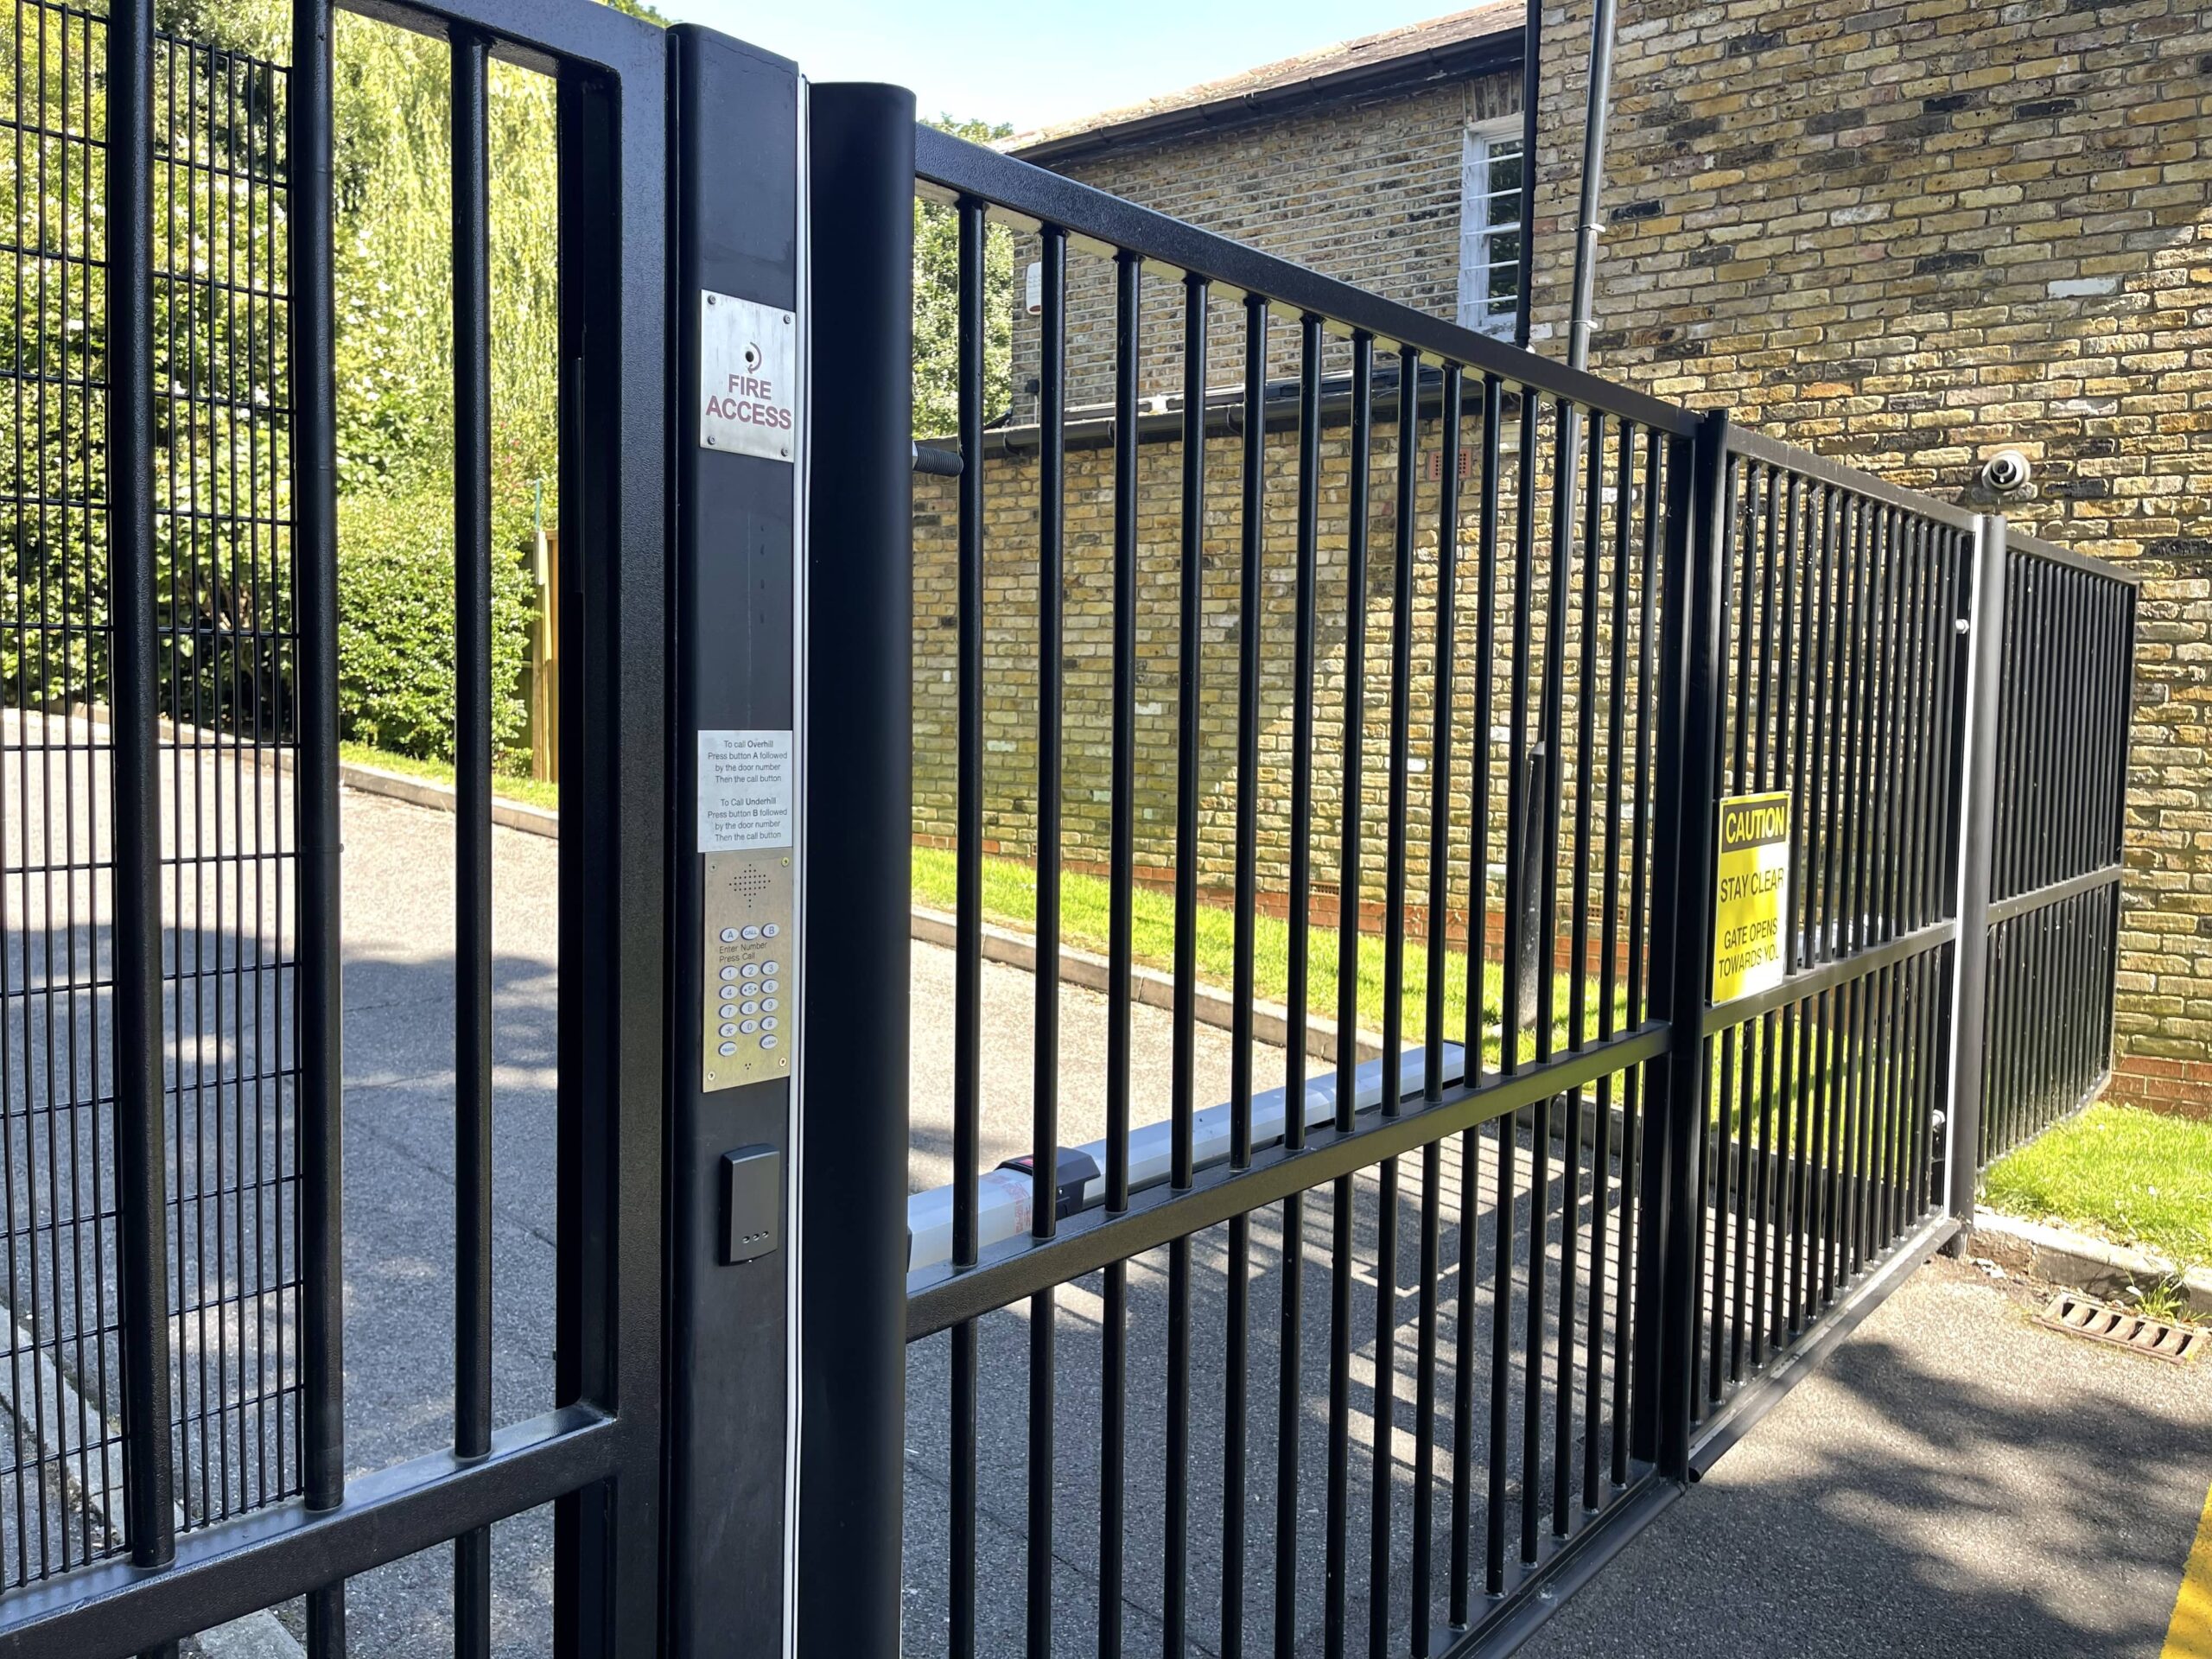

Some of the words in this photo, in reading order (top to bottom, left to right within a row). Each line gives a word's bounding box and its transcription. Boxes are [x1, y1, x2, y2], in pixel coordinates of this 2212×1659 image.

[728, 373, 772, 400] FIRE
[705, 395, 792, 430] ACCESS
[708, 752, 728, 760] Press
[715, 765, 723, 773] by
[1726, 806, 1784, 844] CAUTION
[1720, 874, 1749, 903] STAY
[1751, 867, 1784, 896] CLEAR
[728, 931, 734, 939] A
[769, 925, 775, 935] B
[1724, 926, 1748, 950] GATE
[1749, 918, 1777, 942] OPENS
[719, 945, 738, 954] Enter
[741, 942, 767, 951] Number
[719, 955, 740, 963] Press
[1719, 948, 1763, 979] TOWARDS
